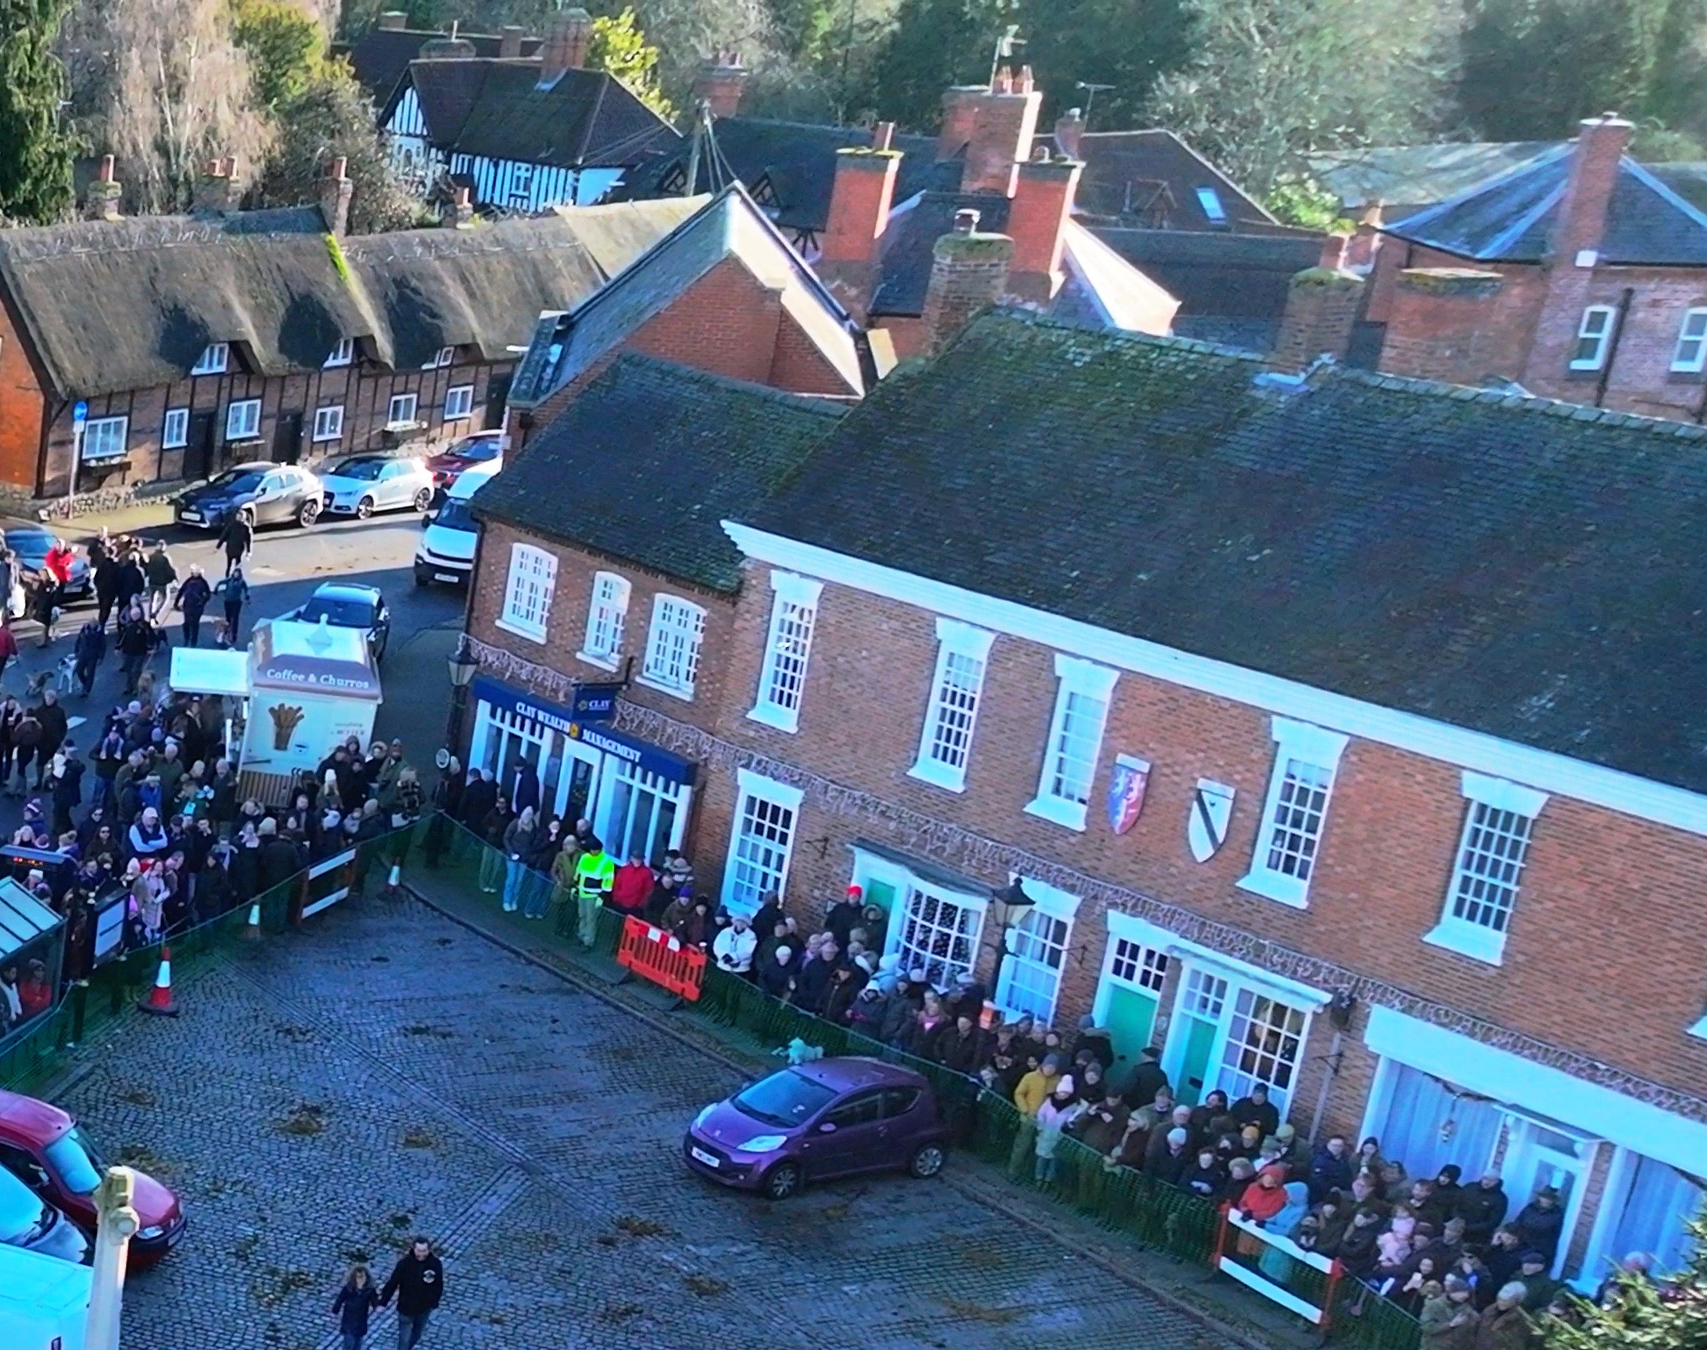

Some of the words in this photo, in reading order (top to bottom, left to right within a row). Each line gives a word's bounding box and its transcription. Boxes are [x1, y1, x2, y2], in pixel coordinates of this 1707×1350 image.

[267, 669, 305, 682] Coffee
[308, 673, 317, 684] &
[320, 674, 370, 689] Churros
[588, 699, 611, 709] CLAY
[516, 701, 537, 719] CLAY
[537, 709, 571, 734] WEALTH
[581, 728, 643, 763] MANAGEMENT
